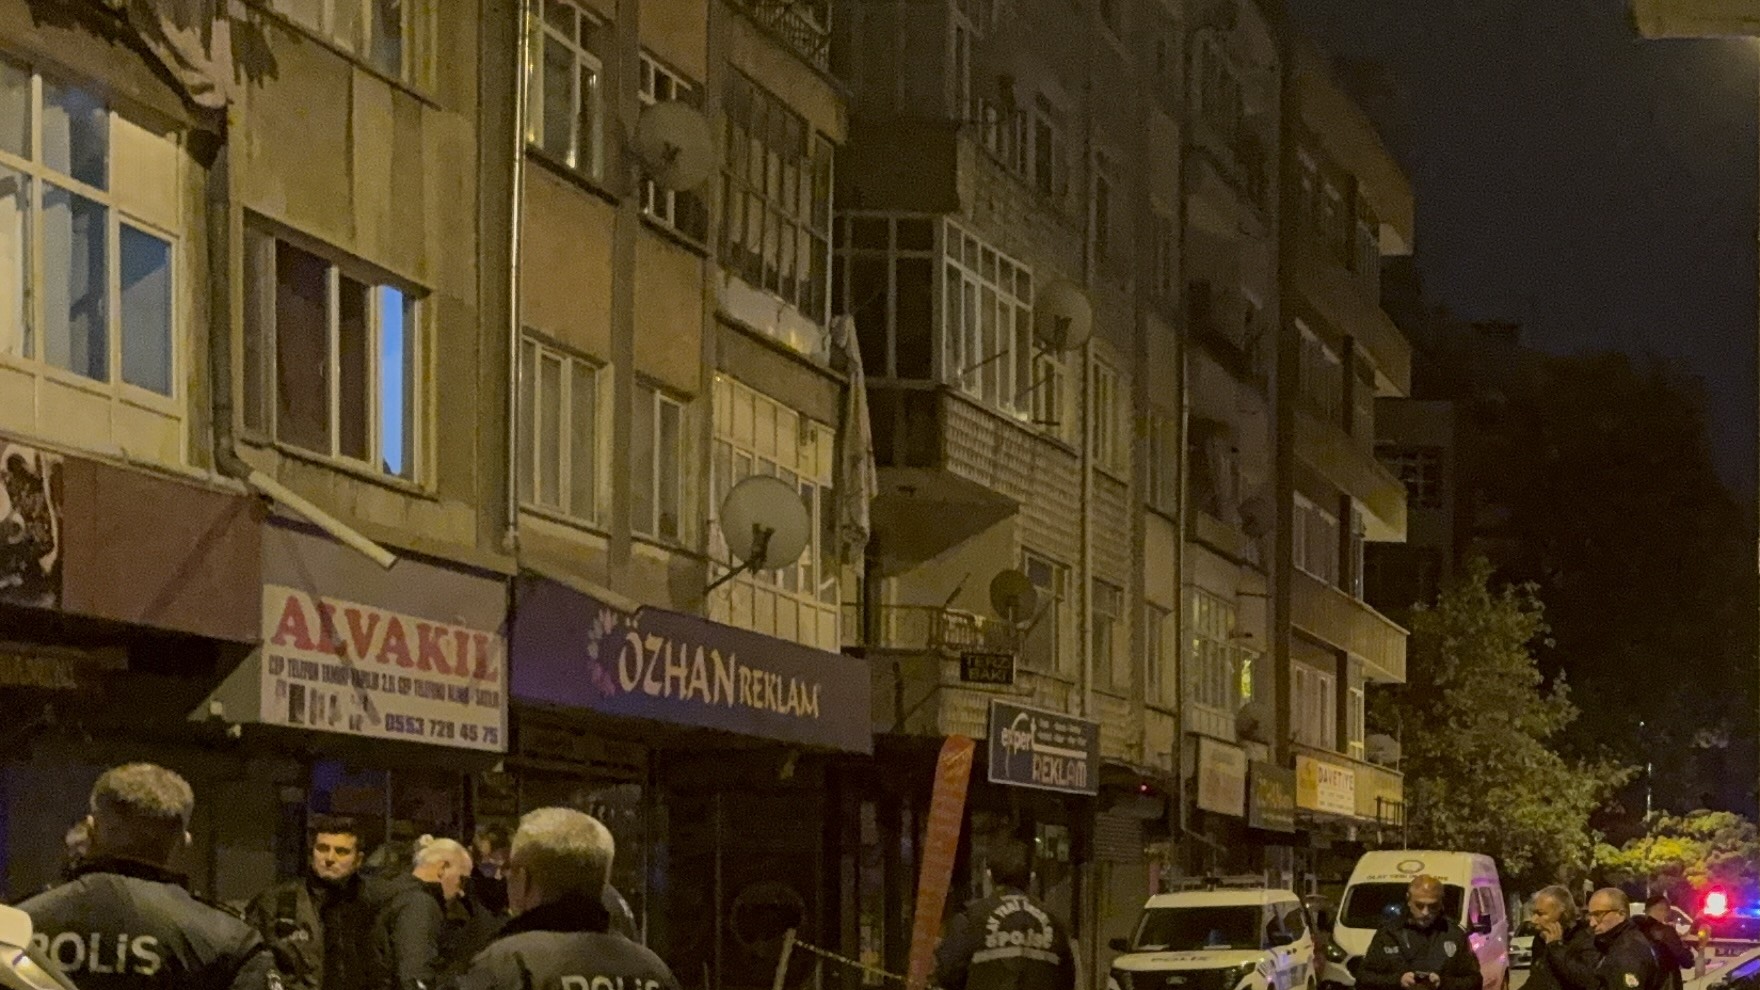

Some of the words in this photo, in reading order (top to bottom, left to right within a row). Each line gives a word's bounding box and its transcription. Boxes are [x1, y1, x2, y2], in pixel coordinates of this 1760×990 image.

[618, 614, 736, 709] ÖZHAN
[739, 664, 820, 720] REKLAM
[1032, 753, 1088, 788] REKLAM
